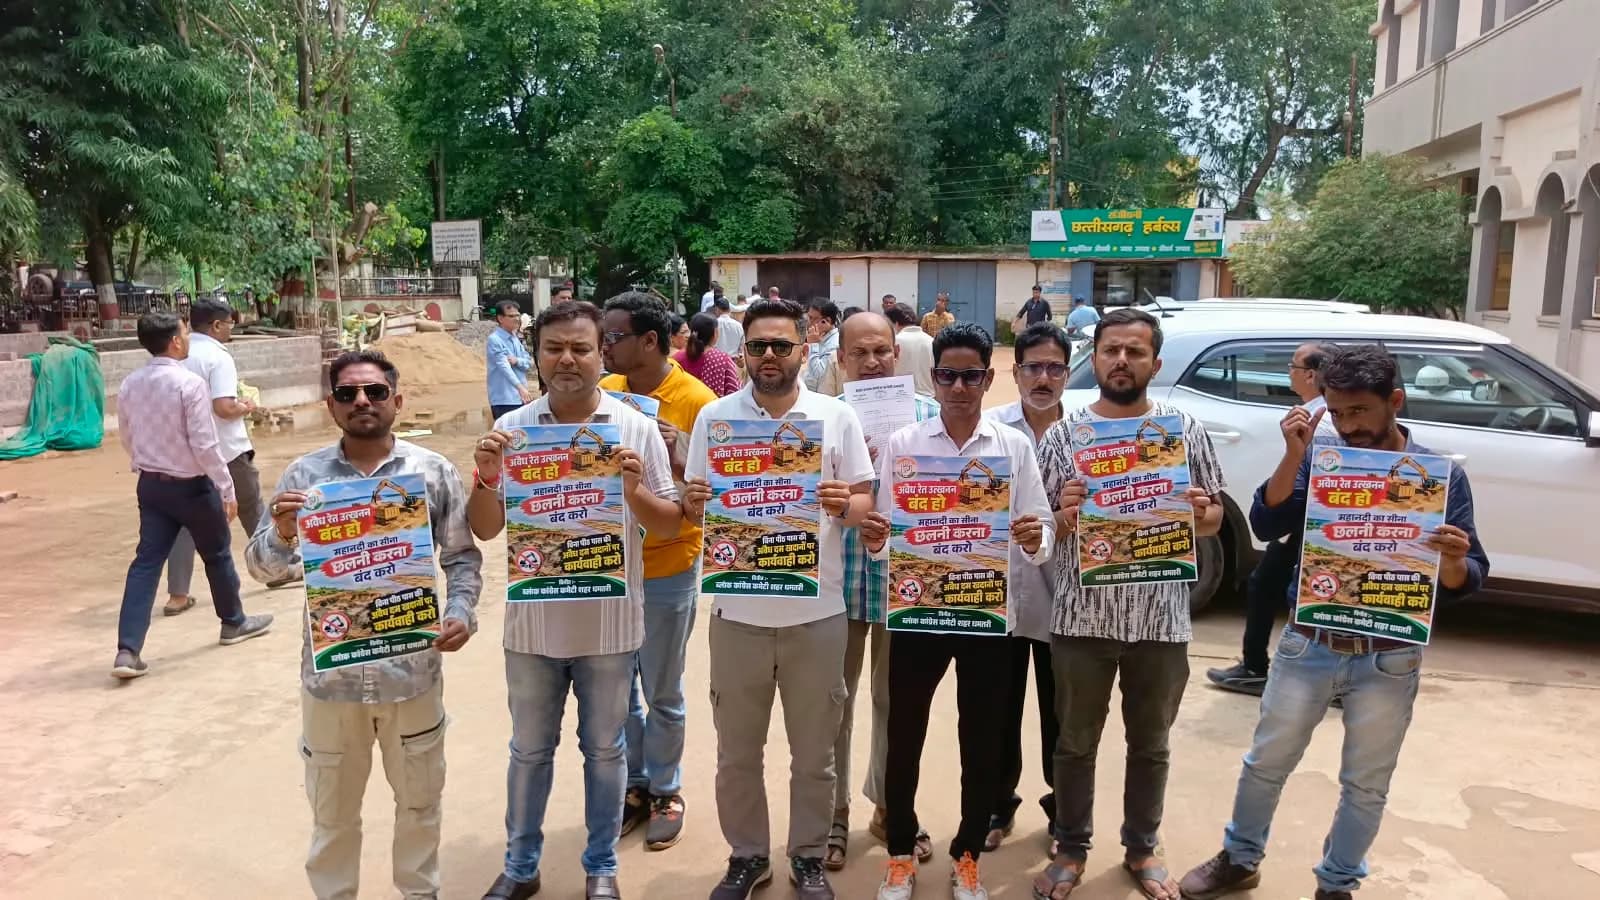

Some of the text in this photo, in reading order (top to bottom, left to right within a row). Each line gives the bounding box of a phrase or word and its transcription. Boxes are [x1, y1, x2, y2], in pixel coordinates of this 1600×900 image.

[1071, 216, 1181, 236] छत्तीसगढ़ हर्बल्स
[510, 453, 568, 467] अवैध रेत उत्खनन
[713, 447, 771, 458] अवैध रेत उत्खनन
[1078, 446, 1136, 462] अवैध रेत उत्खनन
[521, 463, 559, 480] बंद हो
[724, 456, 761, 473] बंद हो
[1089, 456, 1127, 474] बंद हो
[532, 484, 561, 495] महानदी
[574, 482, 592, 490] सीना
[733, 478, 762, 488] महानदी
[774, 477, 792, 485] सीना
[1101, 476, 1130, 488] महानदी
[1143, 473, 1160, 481] सीना
[1317, 477, 1385, 489] अवैध रेत उत्खनन
[729, 488, 799, 505] छलनी करना
[897, 484, 957, 495] अवैध रेत उत्खनन
[1099, 483, 1168, 505] छलनी करना
[1329, 489, 1372, 506] बंद हो
[529, 492, 600, 512] छलनी करना
[747, 503, 786, 517] बंद करो
[908, 494, 946, 510] बंद हो
[1118, 497, 1157, 514] बंद करो
[305, 508, 370, 528] अवैध रेत उत्खनन
[549, 507, 588, 523] बंद करो
[918, 516, 947, 526] महानदी
[961, 515, 979, 523] सीना
[1338, 512, 1371, 521] महानदी
[1386, 513, 1407, 522] सीना
[319, 519, 361, 541] बंद हो
[603, 534, 611, 542] की
[799, 532, 807, 540] की
[914, 526, 986, 542] छलनी करना
[1333, 523, 1414, 538] छलनी करना
[333, 541, 365, 556] महानदी
[379, 536, 398, 545] सीना
[807, 542, 815, 550] पर
[933, 540, 973, 554] बंद करो
[1133, 538, 1190, 558] कार्यवाही करो
[1353, 540, 1398, 553] बंद करो
[330, 546, 407, 574] छलनी करना
[563, 552, 621, 571] कार्यवाही करो
[757, 551, 816, 567] कार्यवाही करो
[353, 562, 396, 583] बंद करो
[986, 570, 994, 578] की
[1411, 573, 1421, 582] की
[414, 588, 423, 597] की
[424, 596, 433, 604] पर
[944, 588, 1003, 604] कार्यवाही करो
[1361, 591, 1430, 608] कार्यवाही करो
[373, 605, 436, 631] कार्यवाही करो
